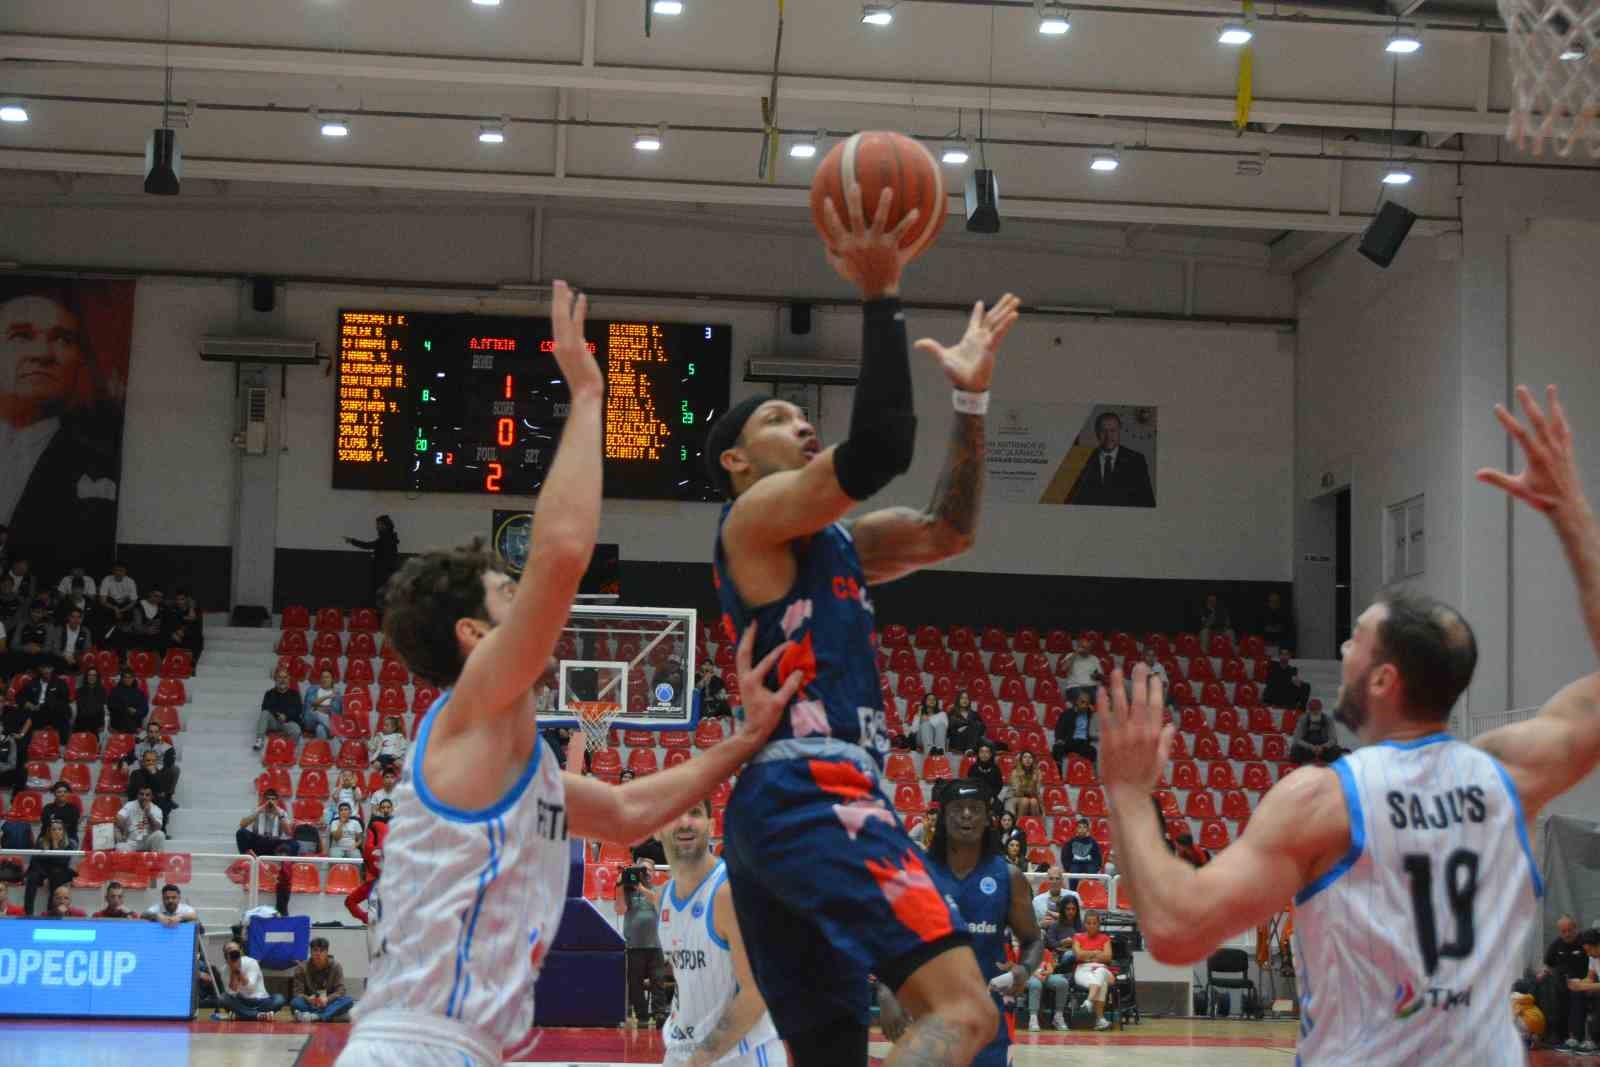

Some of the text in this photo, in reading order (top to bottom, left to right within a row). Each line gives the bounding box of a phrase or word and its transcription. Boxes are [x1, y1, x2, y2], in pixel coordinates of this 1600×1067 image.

[705, 327, 712, 339] 3
[424, 341, 431, 351] 4
[688, 363, 695, 375] 5
[506, 375, 512, 398] 1
[498, 418, 514, 446] 0
[486, 463, 502, 491] 2
[1403, 849, 1480, 977] 19
